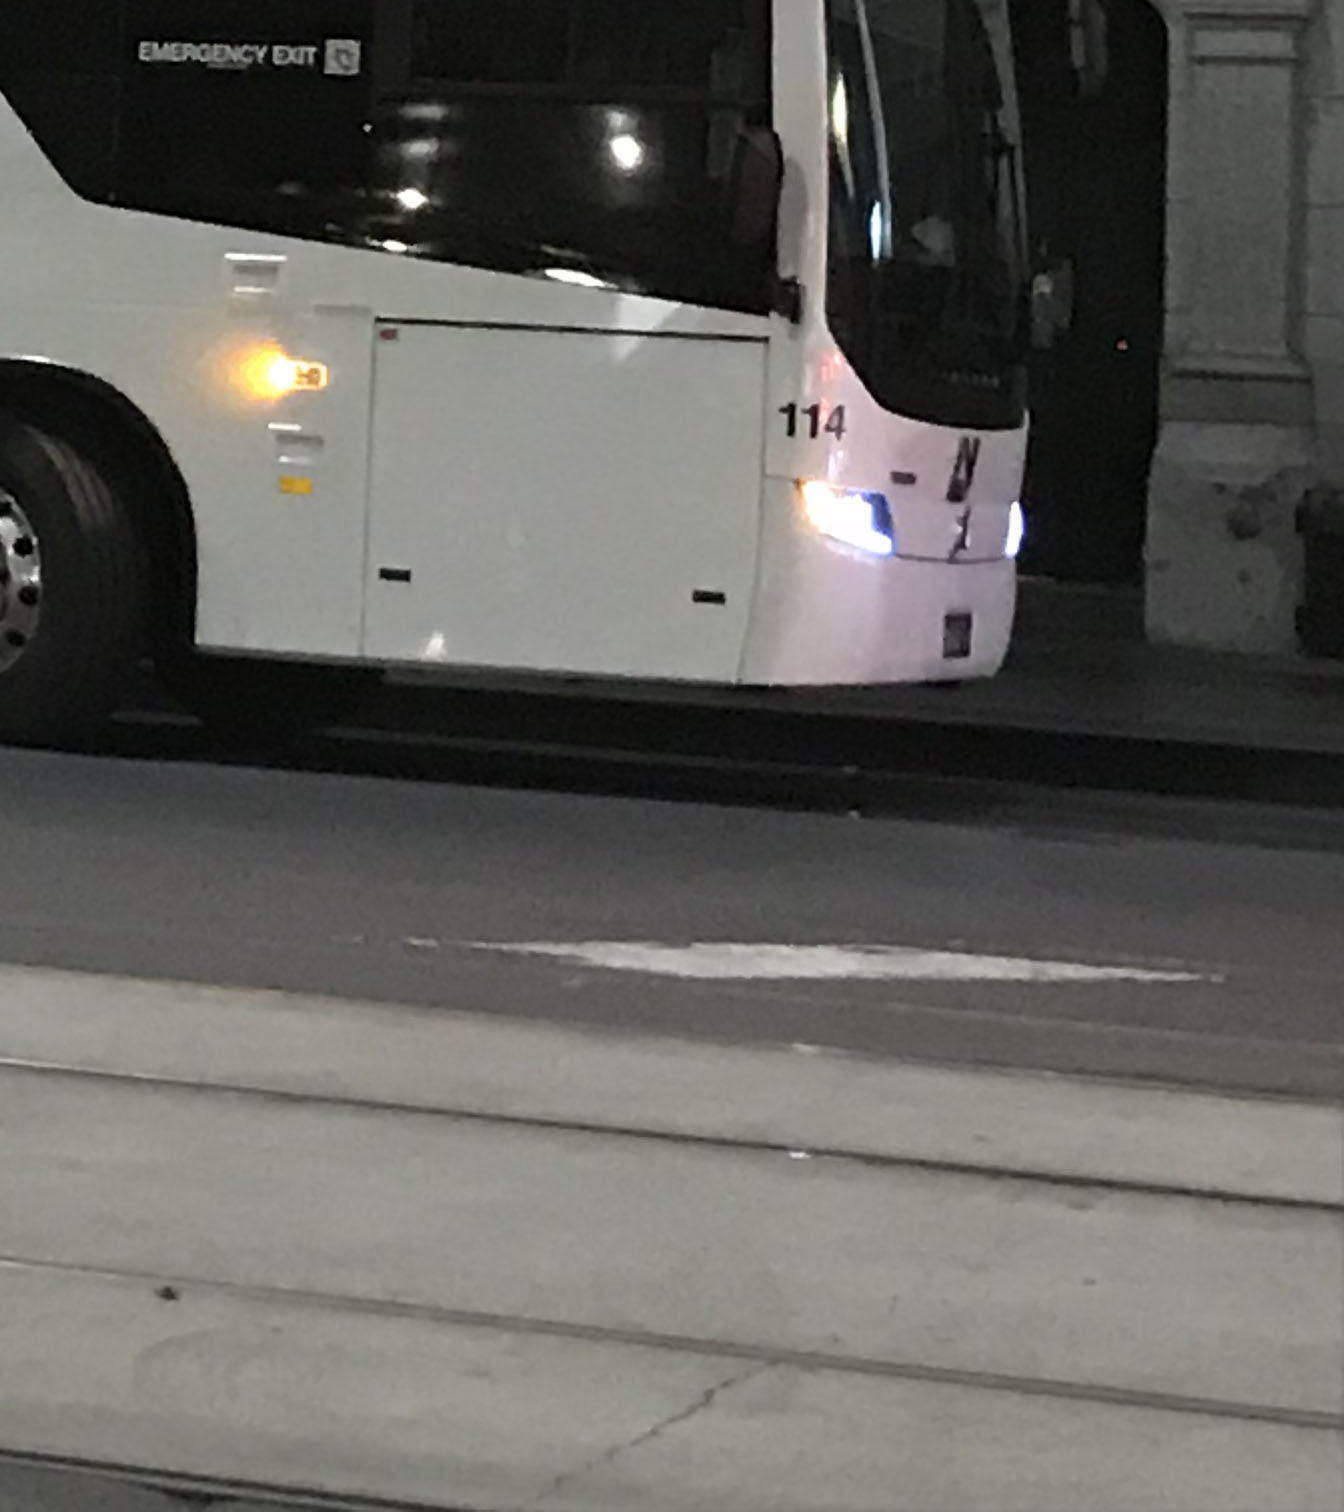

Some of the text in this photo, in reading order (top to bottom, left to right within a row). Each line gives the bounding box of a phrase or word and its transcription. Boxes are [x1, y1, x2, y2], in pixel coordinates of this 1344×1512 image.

[138, 41, 318, 66] EMERGENCY EXIT
[778, 401, 847, 440] 114
